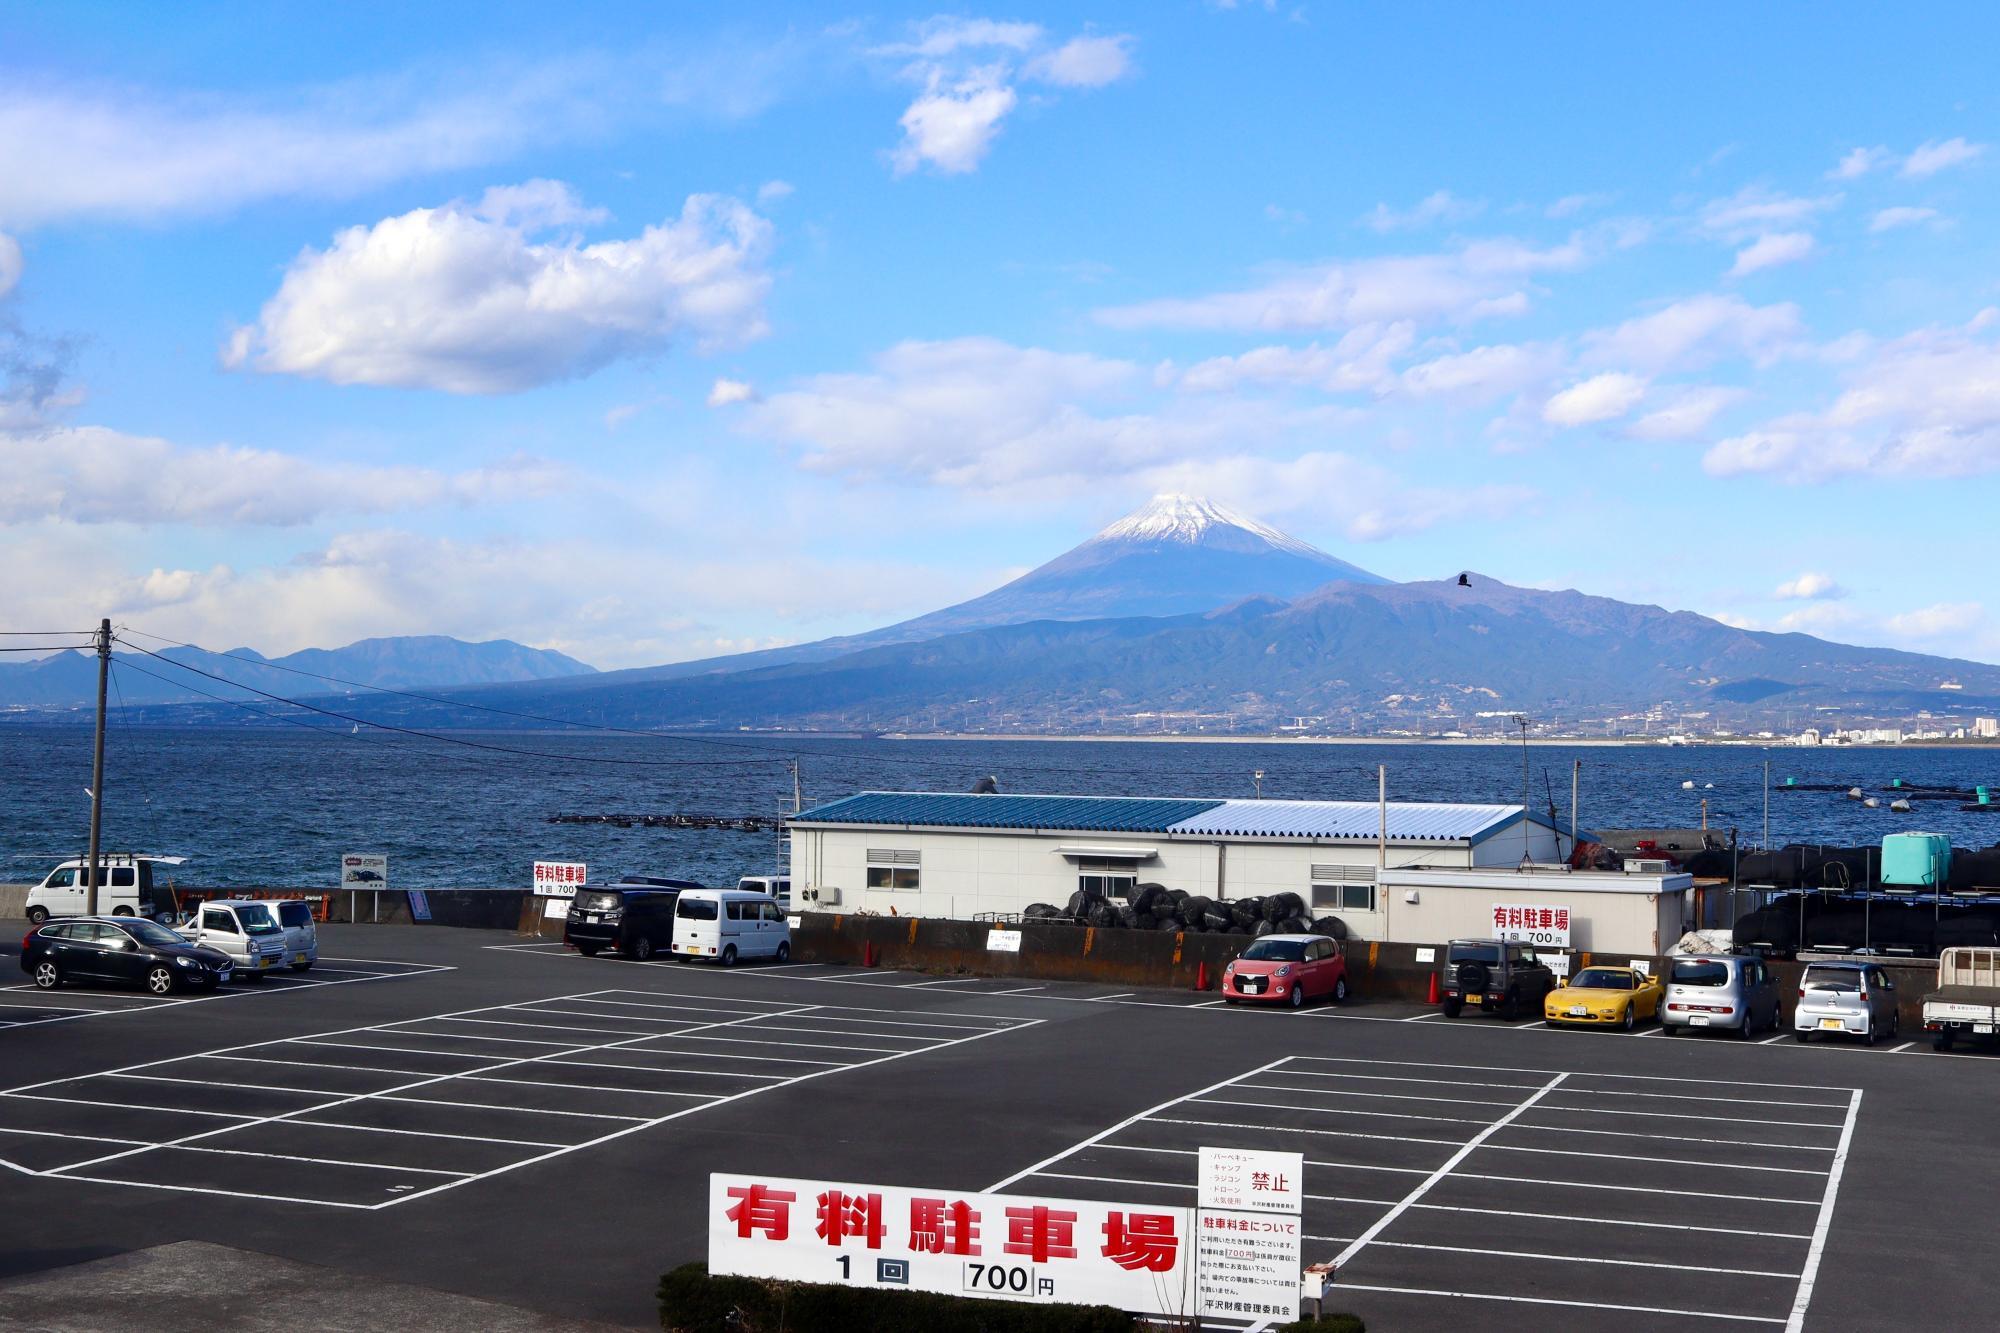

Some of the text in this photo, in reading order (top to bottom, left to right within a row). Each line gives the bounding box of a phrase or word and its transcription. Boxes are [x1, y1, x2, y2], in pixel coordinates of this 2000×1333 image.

[535, 864, 585, 884] 有料駐車場
[1494, 906, 1569, 931] 有料駐車場
[1213, 1175, 1241, 1183] ラジコン
[1251, 1171, 1290, 1193] 禁止
[1213, 1186, 1241, 1194] ドローン
[1213, 1196, 1242, 1205] 火気使用
[725, 1184, 1179, 1272] 有料駐車場
[1203, 1216, 1295, 1235] 駐車料金について
[1205, 1299, 1290, 1316] 平沢財産管理委員会
